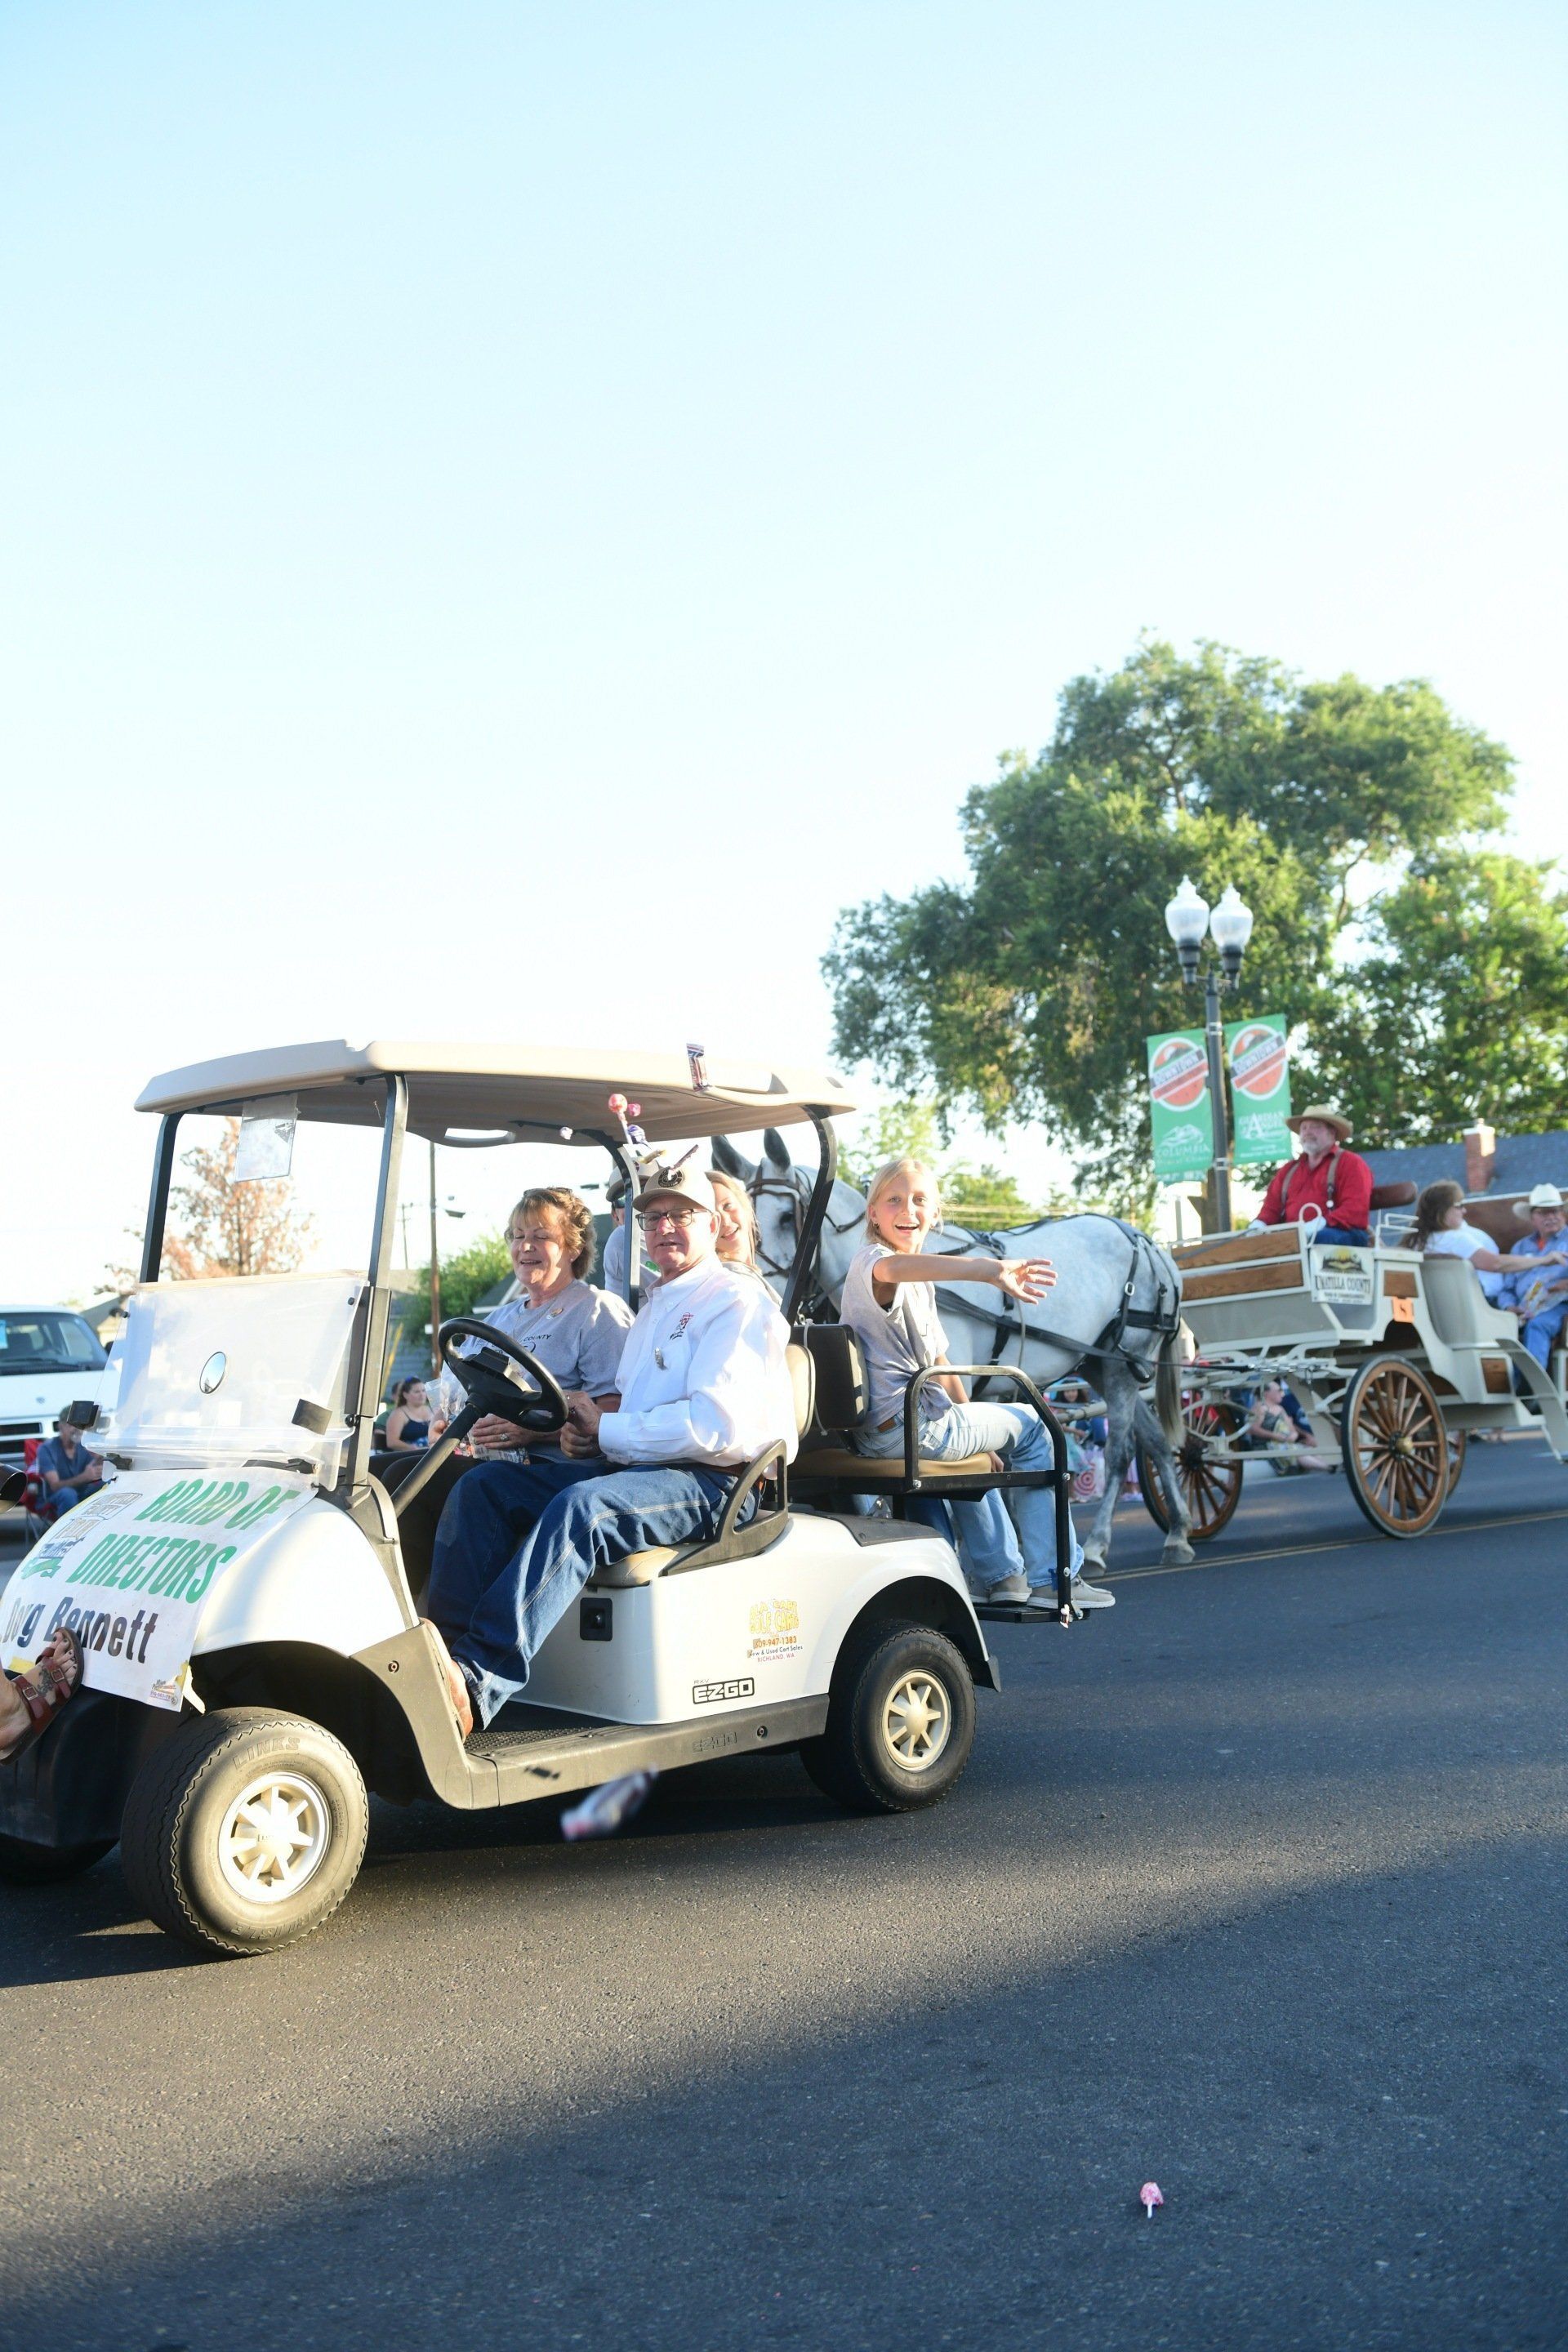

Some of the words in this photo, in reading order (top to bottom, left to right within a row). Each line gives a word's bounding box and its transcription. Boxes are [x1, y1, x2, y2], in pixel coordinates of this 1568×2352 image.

[134, 1478, 250, 1526] BOARD
[225, 1486, 301, 1530] OF
[65, 1533, 238, 1604] DIRECTORS
[43, 1597, 158, 1664] Bennett
[693, 1677, 755, 1704] EZGO
[233, 1737, 300, 1770] LINKS
